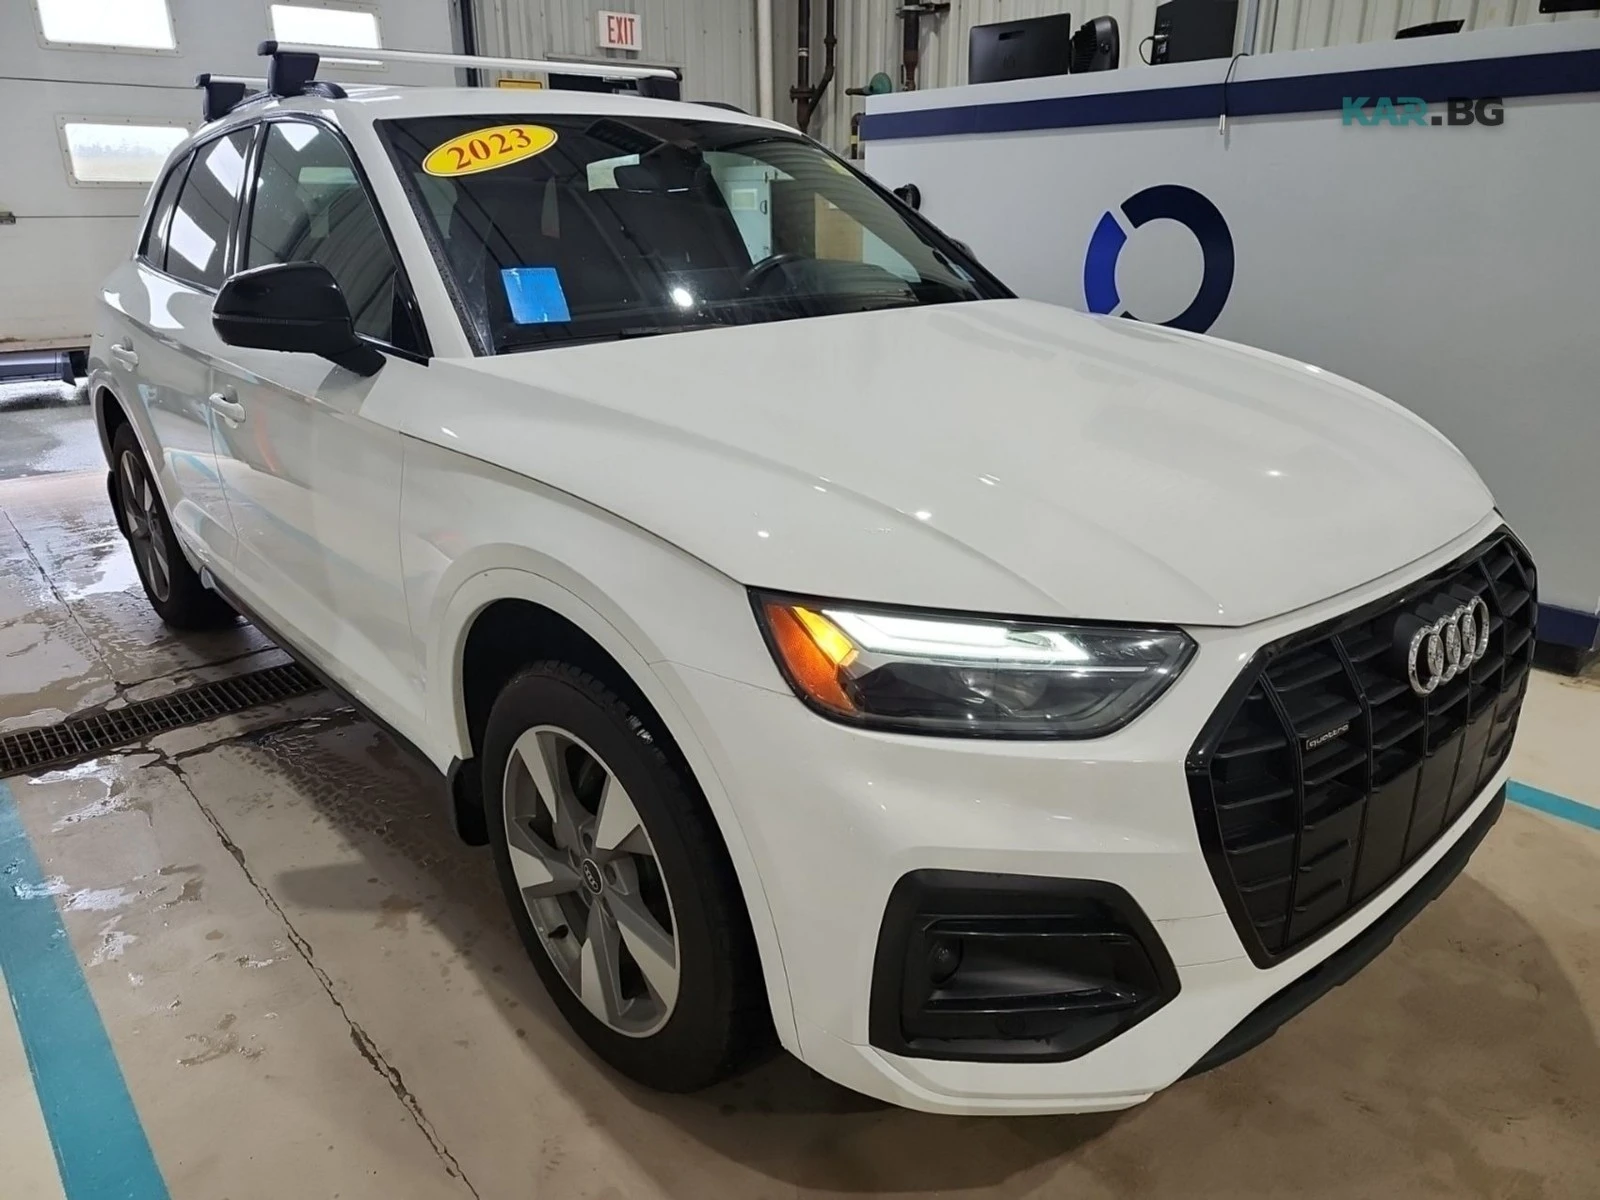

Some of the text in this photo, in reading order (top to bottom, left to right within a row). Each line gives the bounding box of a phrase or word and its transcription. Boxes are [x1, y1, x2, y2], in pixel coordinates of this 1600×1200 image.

[607, 15, 635, 45] EXIT
[447, 128, 532, 169] 2023
[1308, 724, 1349, 748] quattro
